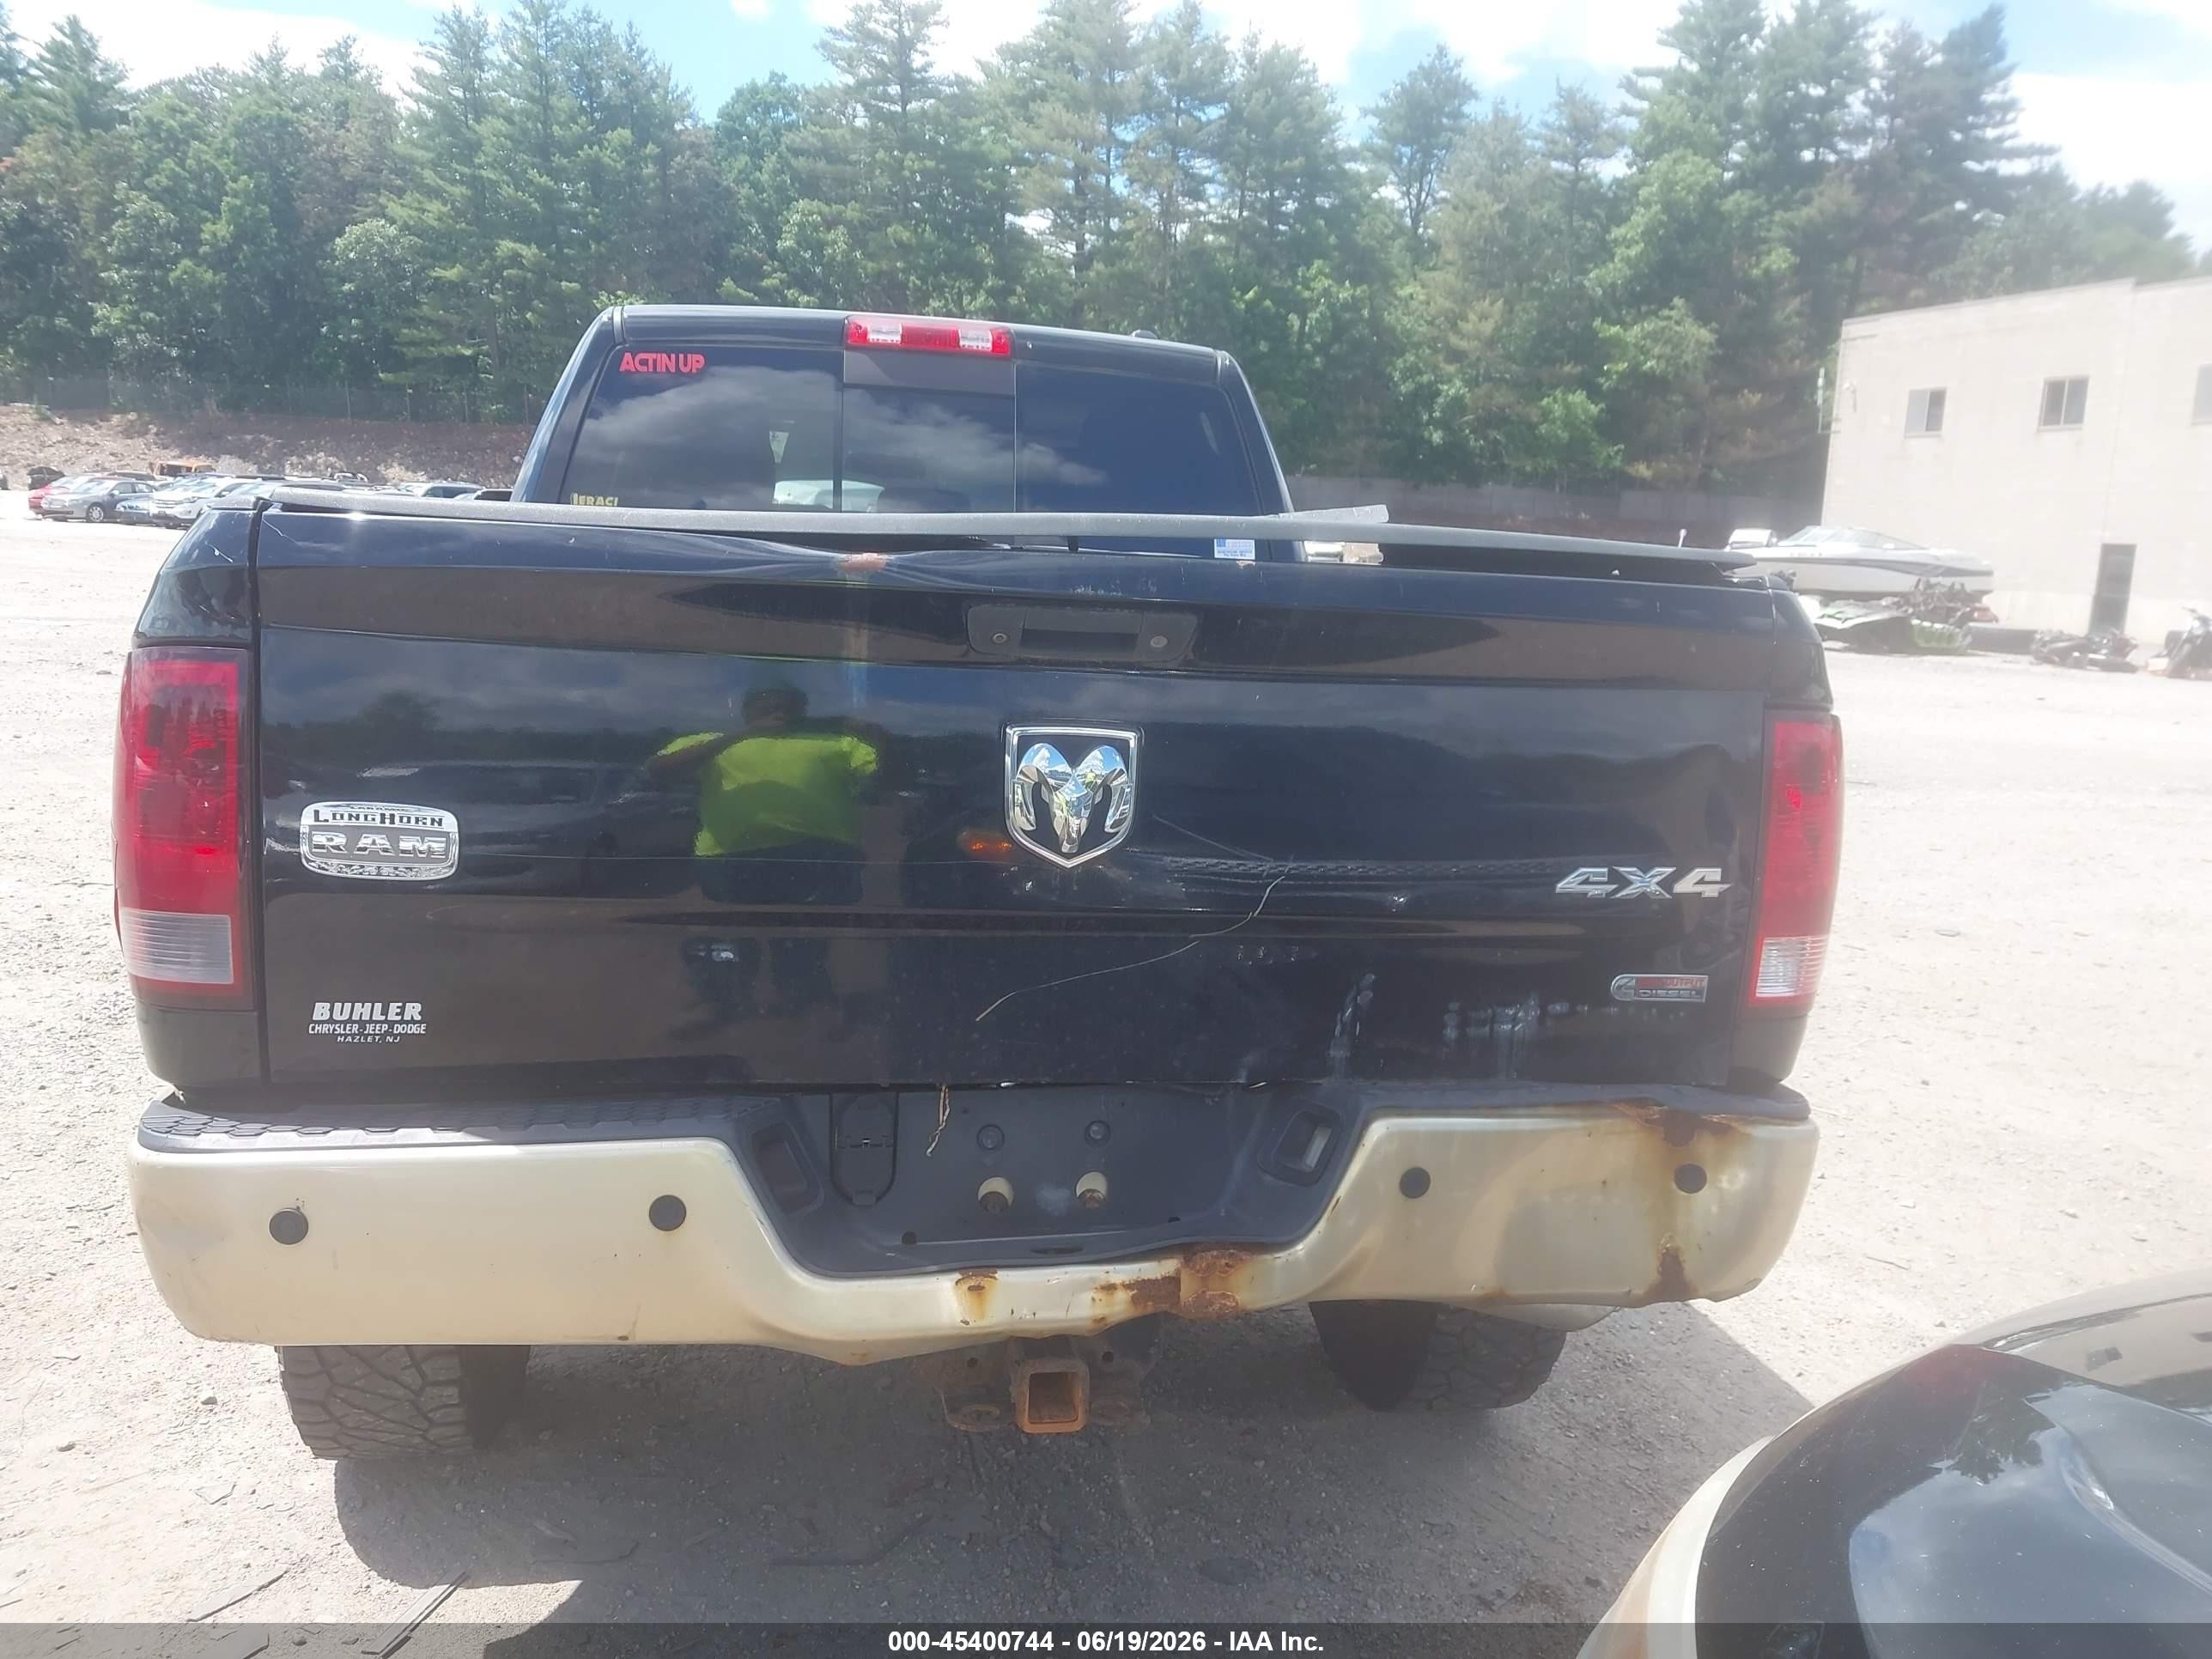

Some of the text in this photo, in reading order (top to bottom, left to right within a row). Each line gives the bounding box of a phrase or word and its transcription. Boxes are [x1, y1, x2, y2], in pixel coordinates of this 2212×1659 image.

[619, 352, 705, 373] ACTIN UP
[311, 830, 447, 859] RAM
[1638, 989, 1702, 998] DIESEL
[312, 1002, 422, 1021] BUHLER
